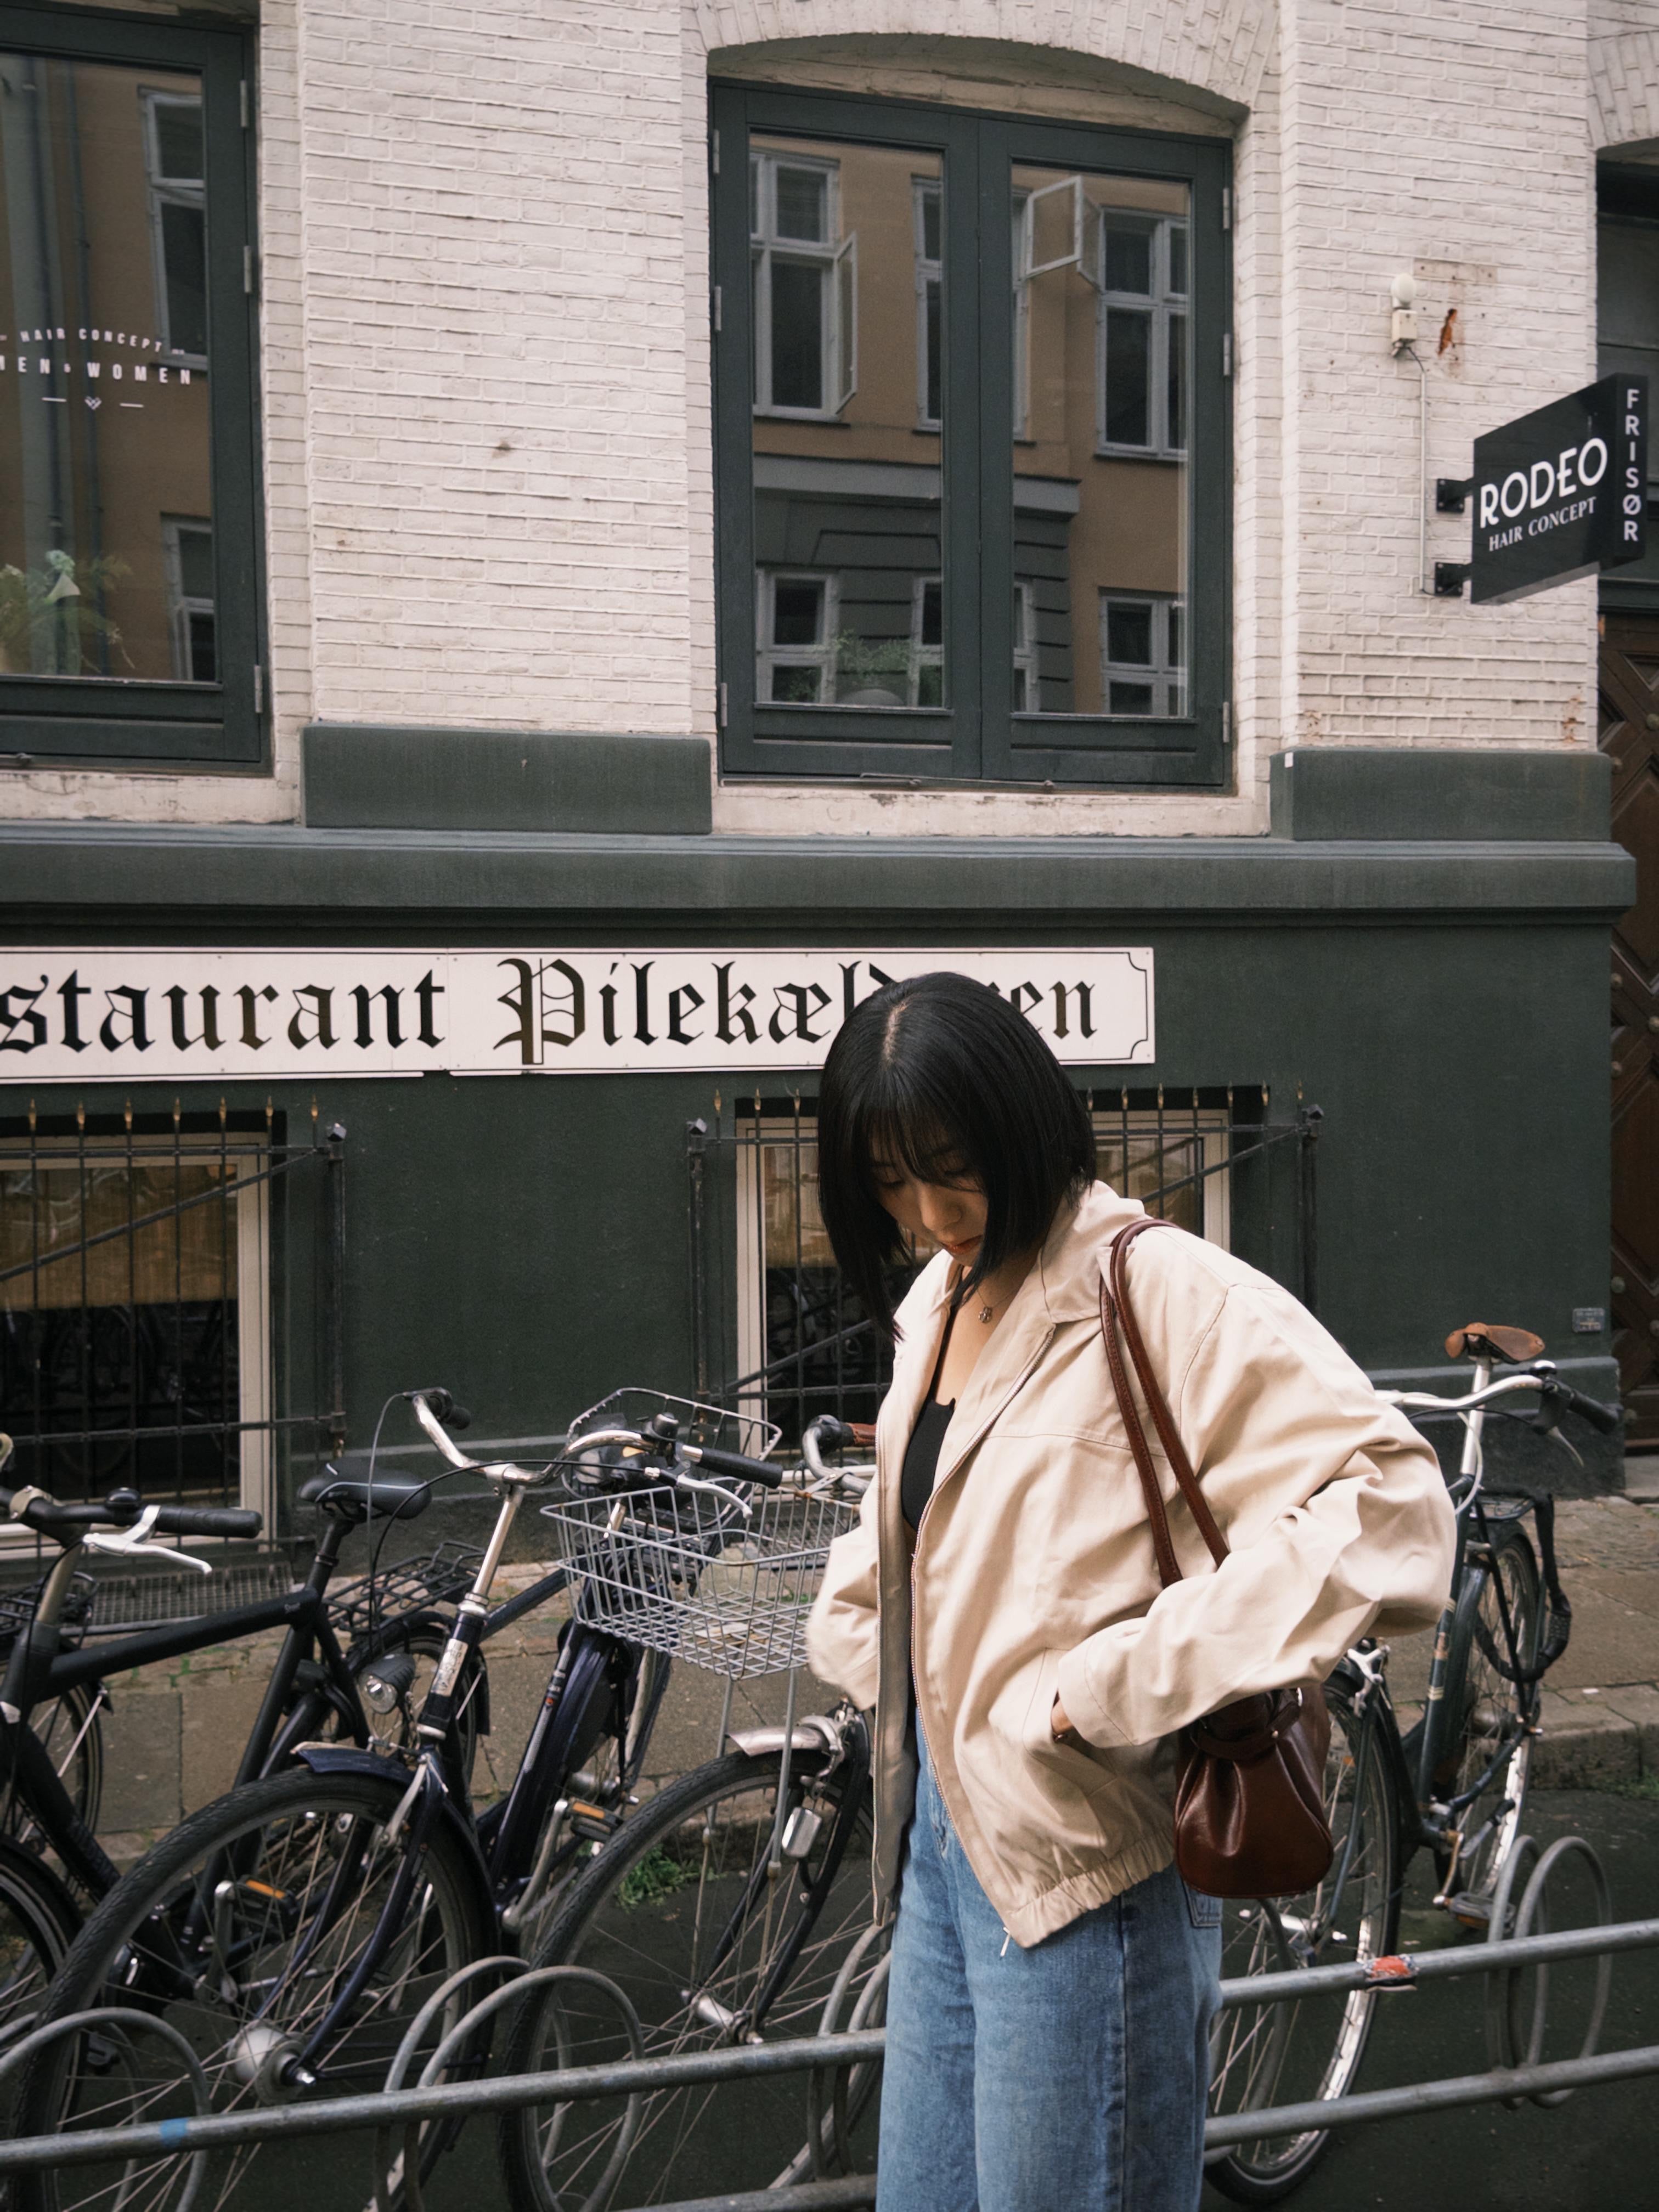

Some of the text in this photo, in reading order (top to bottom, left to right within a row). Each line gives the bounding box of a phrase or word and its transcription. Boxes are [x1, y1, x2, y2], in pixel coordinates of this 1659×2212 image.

[20, 328, 162, 353] HAIR CONCEPT
[87, 362, 191, 385] WOMEN
[1480, 438, 1608, 528] RODEO
[1622, 388, 1641, 542] FRISØR
[1488, 496, 1597, 551] HAIR CONCEPT
